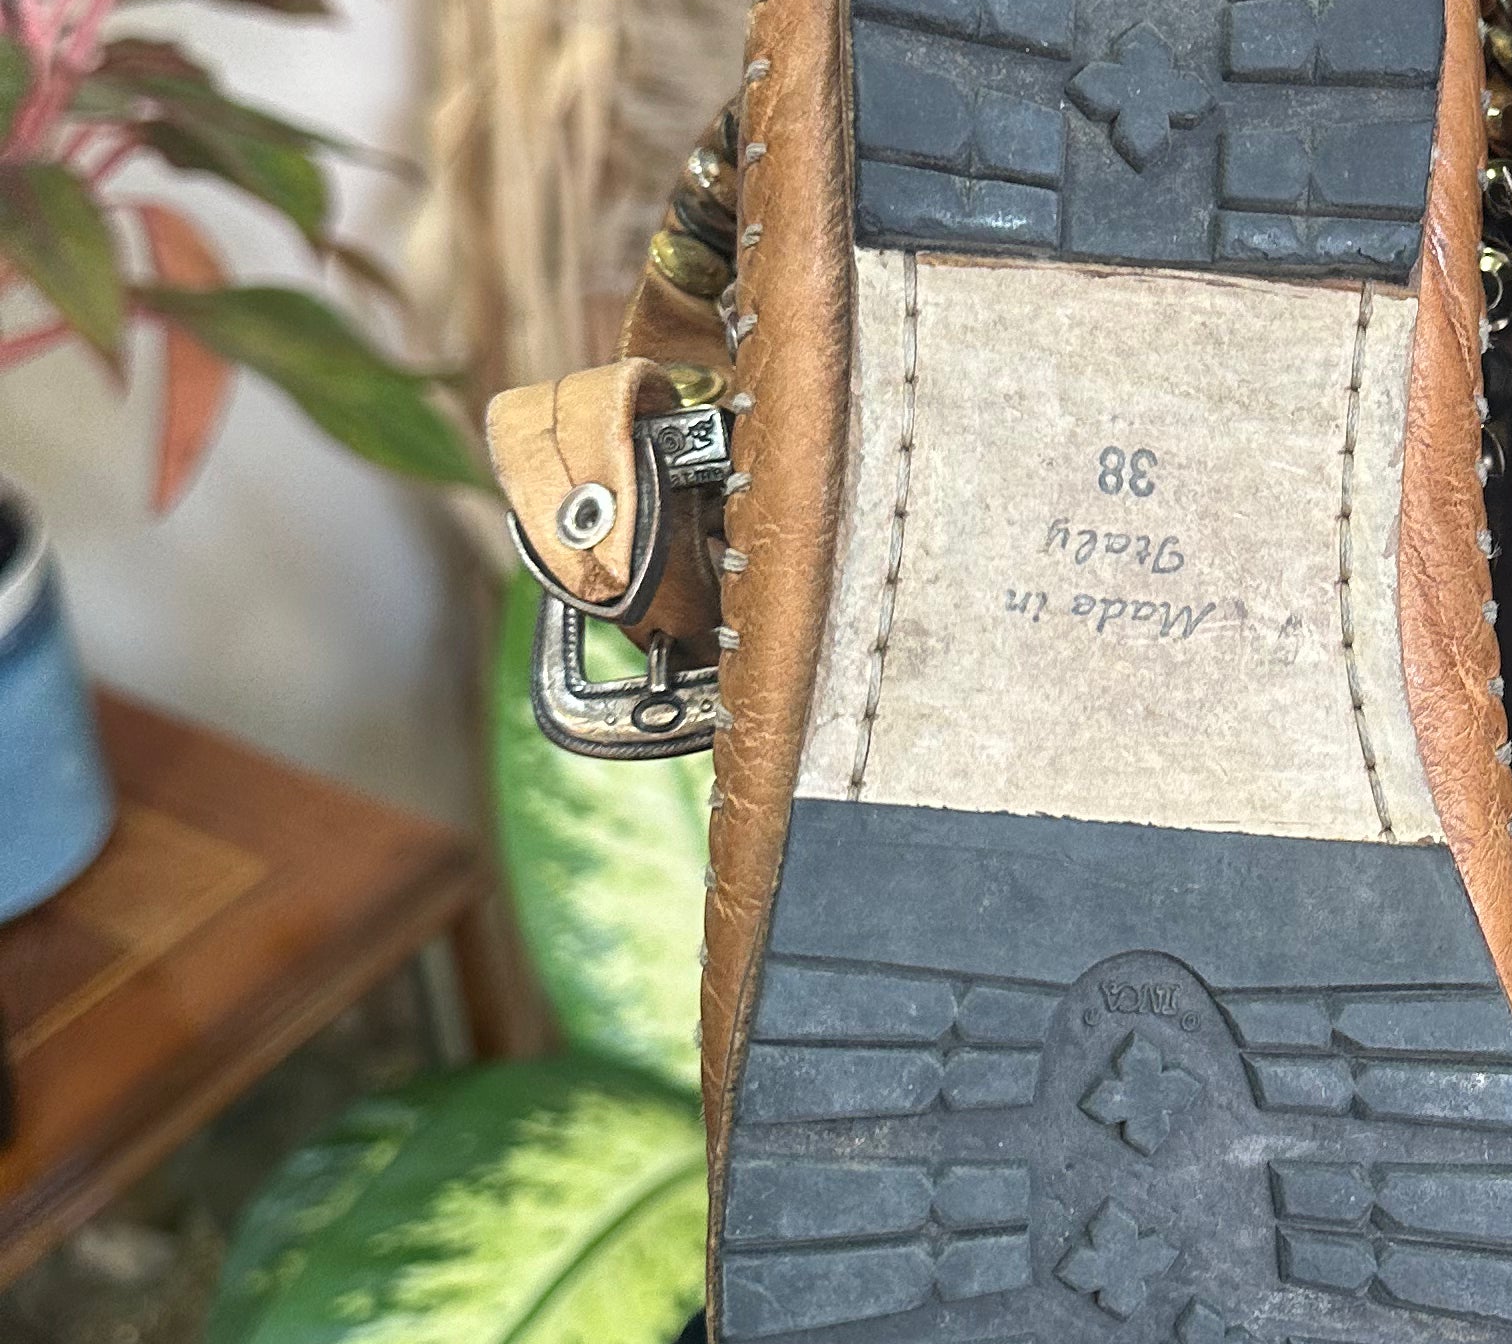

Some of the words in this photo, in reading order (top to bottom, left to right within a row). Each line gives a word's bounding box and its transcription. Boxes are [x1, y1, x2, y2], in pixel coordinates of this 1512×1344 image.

[1098, 445, 1158, 497] 38
[1045, 516, 1186, 575] Italy
[1004, 588, 1048, 624] in
[1070, 593, 1218, 639] Made
